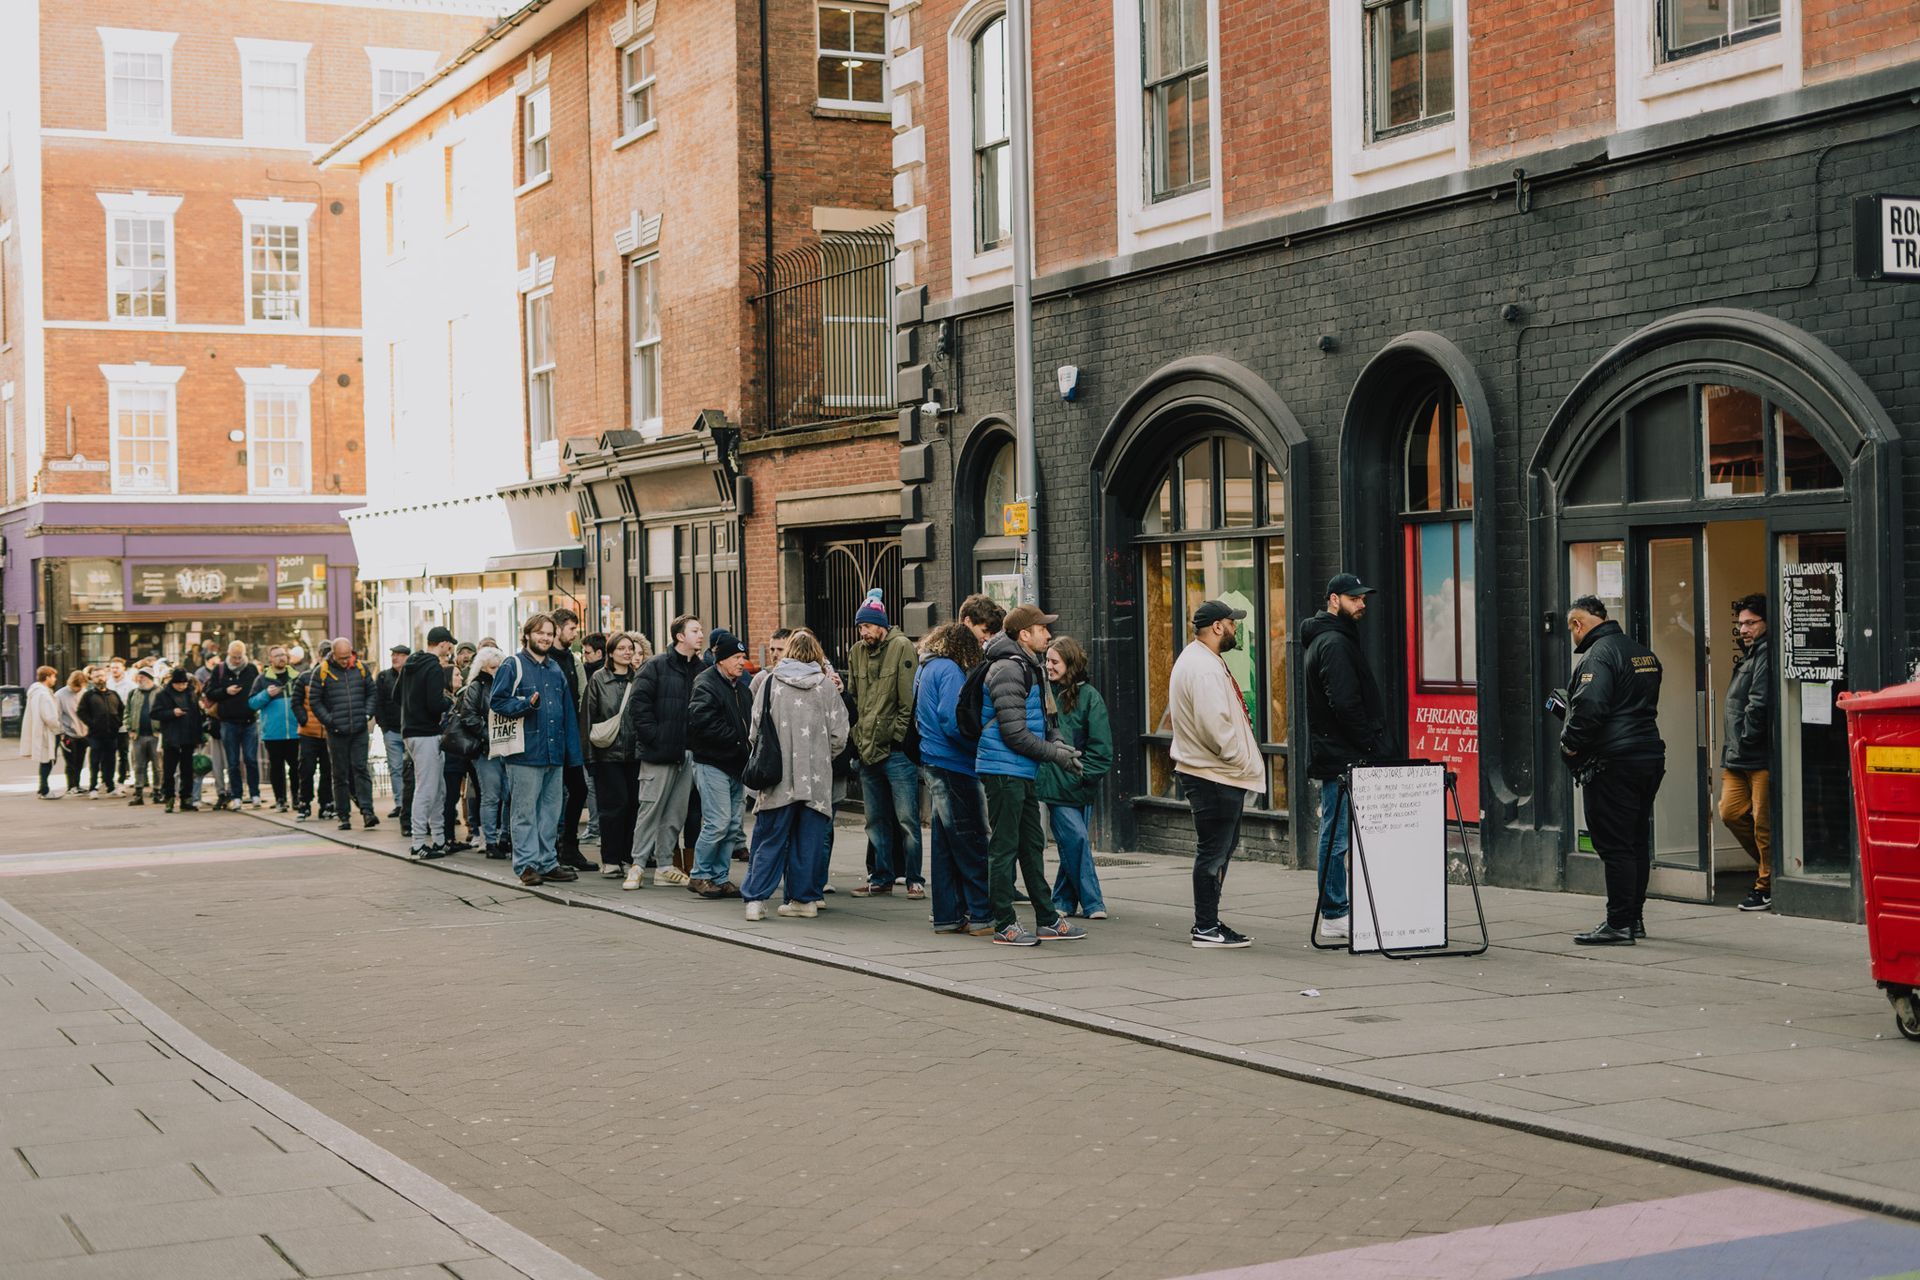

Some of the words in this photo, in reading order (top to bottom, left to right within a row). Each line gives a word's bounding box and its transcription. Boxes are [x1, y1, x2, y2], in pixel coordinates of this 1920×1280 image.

[1892, 238, 1920, 268] TR
[1631, 655, 1656, 666] SECURITY
[1416, 736, 1424, 750] A
[1433, 737, 1448, 751] LA
[1358, 769, 1383, 781] RECORD
[1384, 768, 1403, 778] STORE
